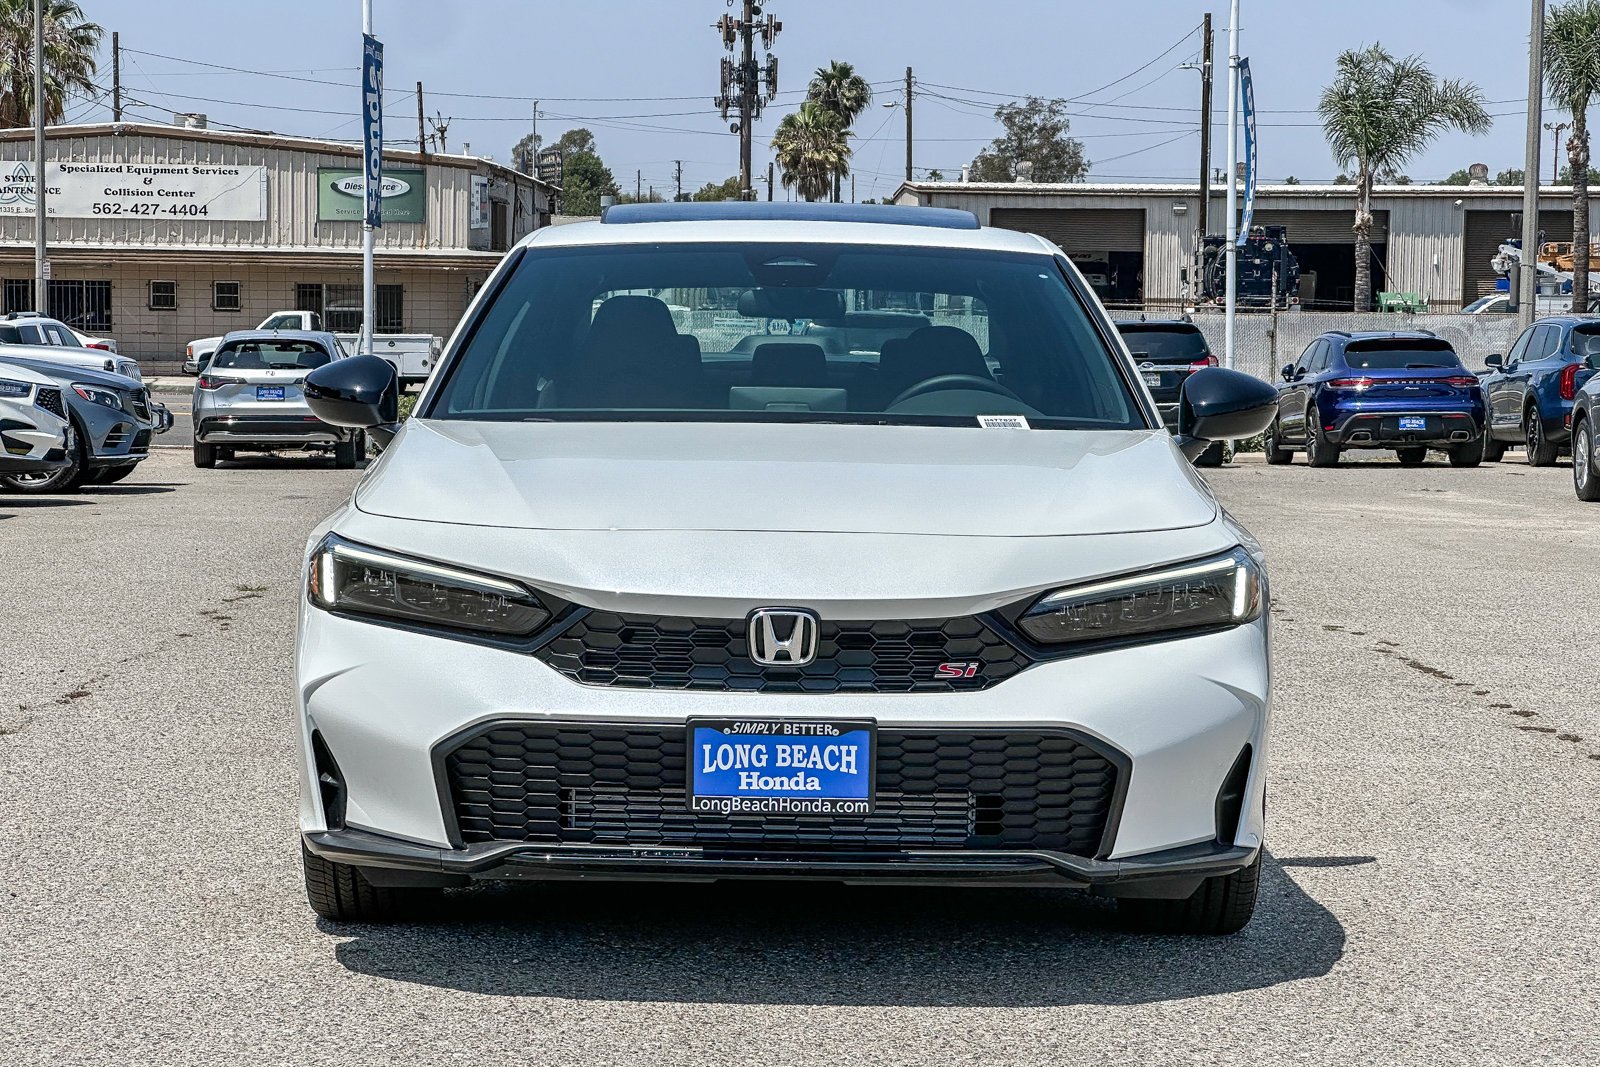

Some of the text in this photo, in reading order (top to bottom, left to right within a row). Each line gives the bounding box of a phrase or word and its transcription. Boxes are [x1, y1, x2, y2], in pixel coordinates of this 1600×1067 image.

[60, 164, 239, 175] Specialized Equipment Services
[143, 177, 153, 185] &
[104, 188, 196, 198] Collision Center
[92, 203, 208, 216] 562-427-4404
[935, 663, 979, 678] Si
[731, 723, 833, 735] SIMPLY BETTER
[702, 744, 858, 774] LONG BEACH
[738, 771, 821, 791] Honda
[692, 796, 869, 814] LongBeachHonda.com
